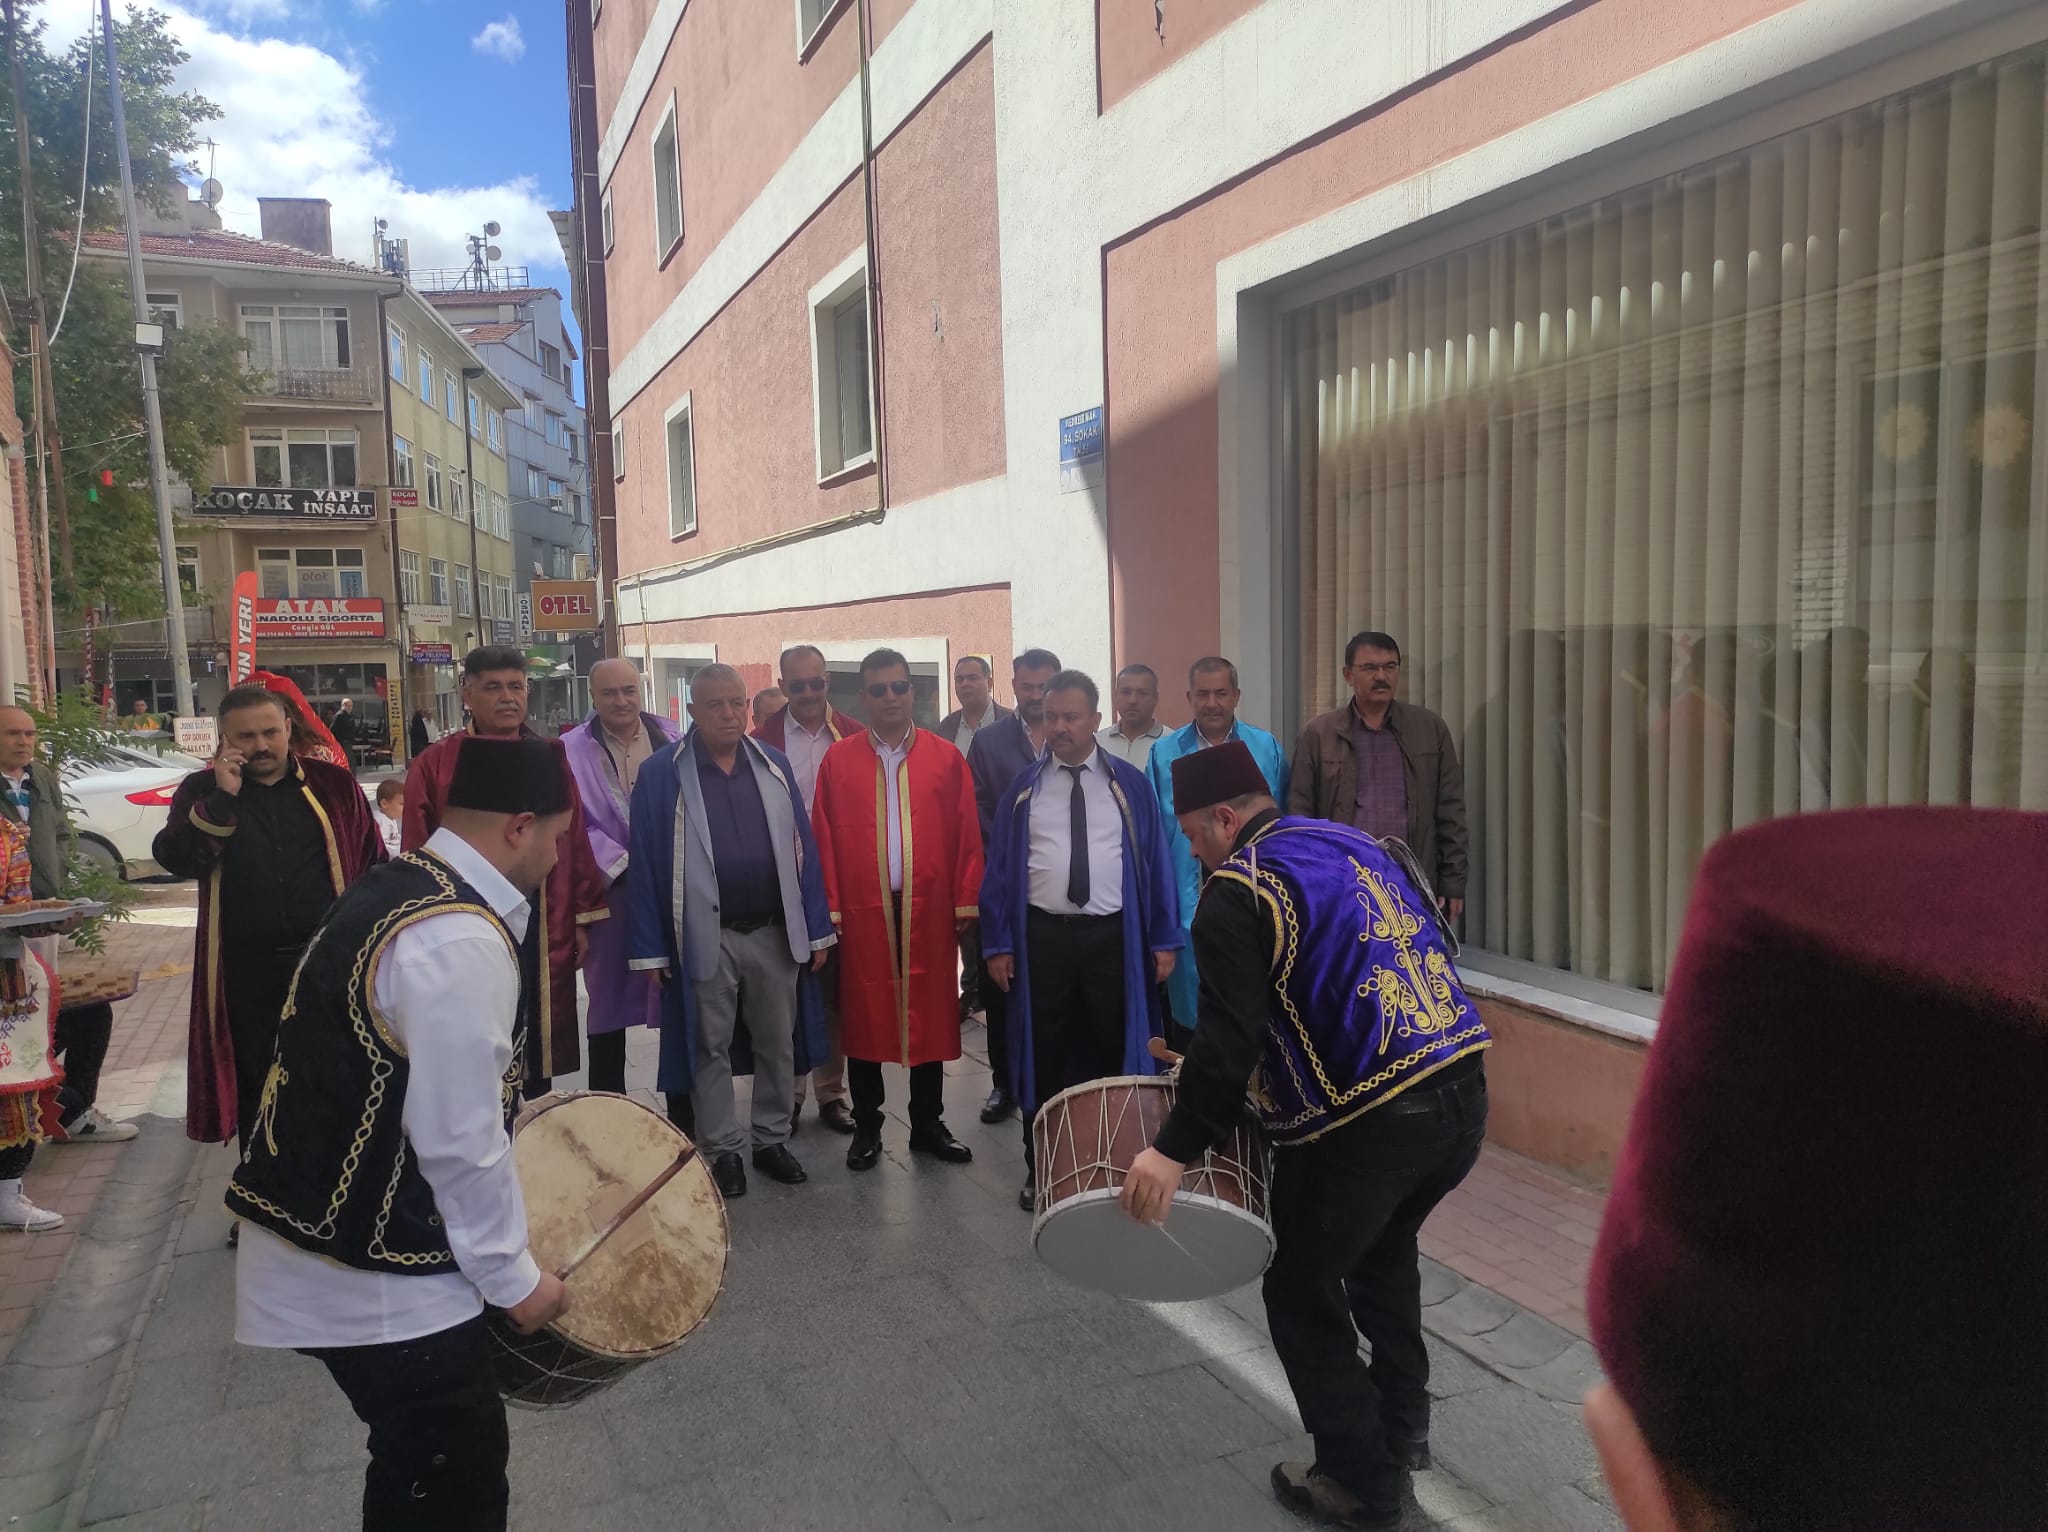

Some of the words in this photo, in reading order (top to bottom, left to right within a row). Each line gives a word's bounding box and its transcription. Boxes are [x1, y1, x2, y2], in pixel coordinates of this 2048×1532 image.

[195, 491, 294, 514] KOÇAK
[313, 490, 360, 503] YAPI
[303, 500, 372, 517] İNŞAAT
[275, 600, 350, 613] ATAK
[540, 595, 592, 616] OTEL
[238, 595, 252, 644] YERİ
[318, 613, 375, 622] SİGORTA
